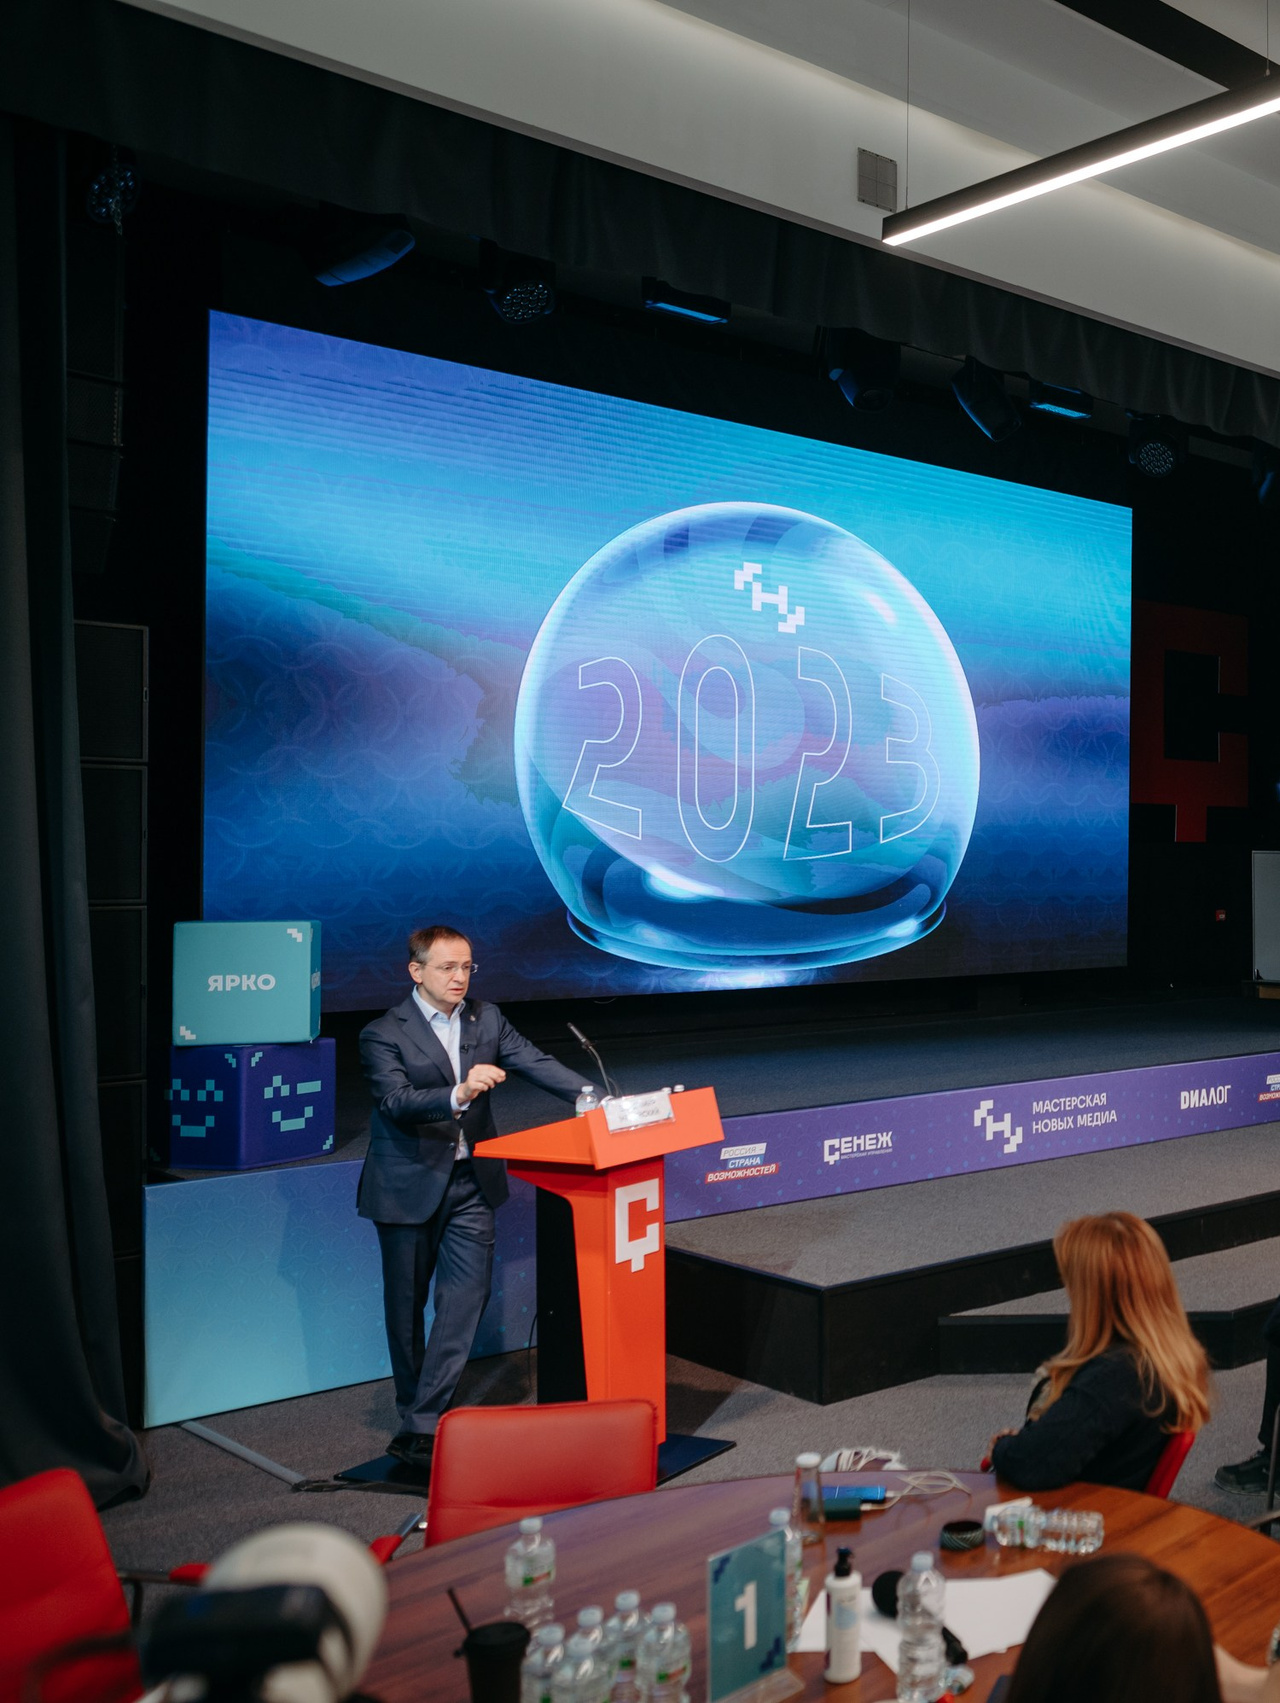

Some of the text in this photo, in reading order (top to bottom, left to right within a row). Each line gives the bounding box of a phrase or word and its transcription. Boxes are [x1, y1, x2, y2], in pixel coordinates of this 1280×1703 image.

[561, 634, 941, 863] 2023
[207, 973, 276, 992] ЯРКО
[1032, 1092, 1107, 1115] МАСТЕРСКАЯ
[1032, 1110, 1118, 1134] НОВЫХ МЕДИА
[722, 1144, 757, 1158] РОССИЯ
[823, 1131, 893, 1166] СЕНЕЖ
[707, 1163, 776, 1182] ВОЗМОЖНОСТЕЙ
[728, 1158, 762, 1168] СТРАНА
[734, 1580, 758, 1651] 1
